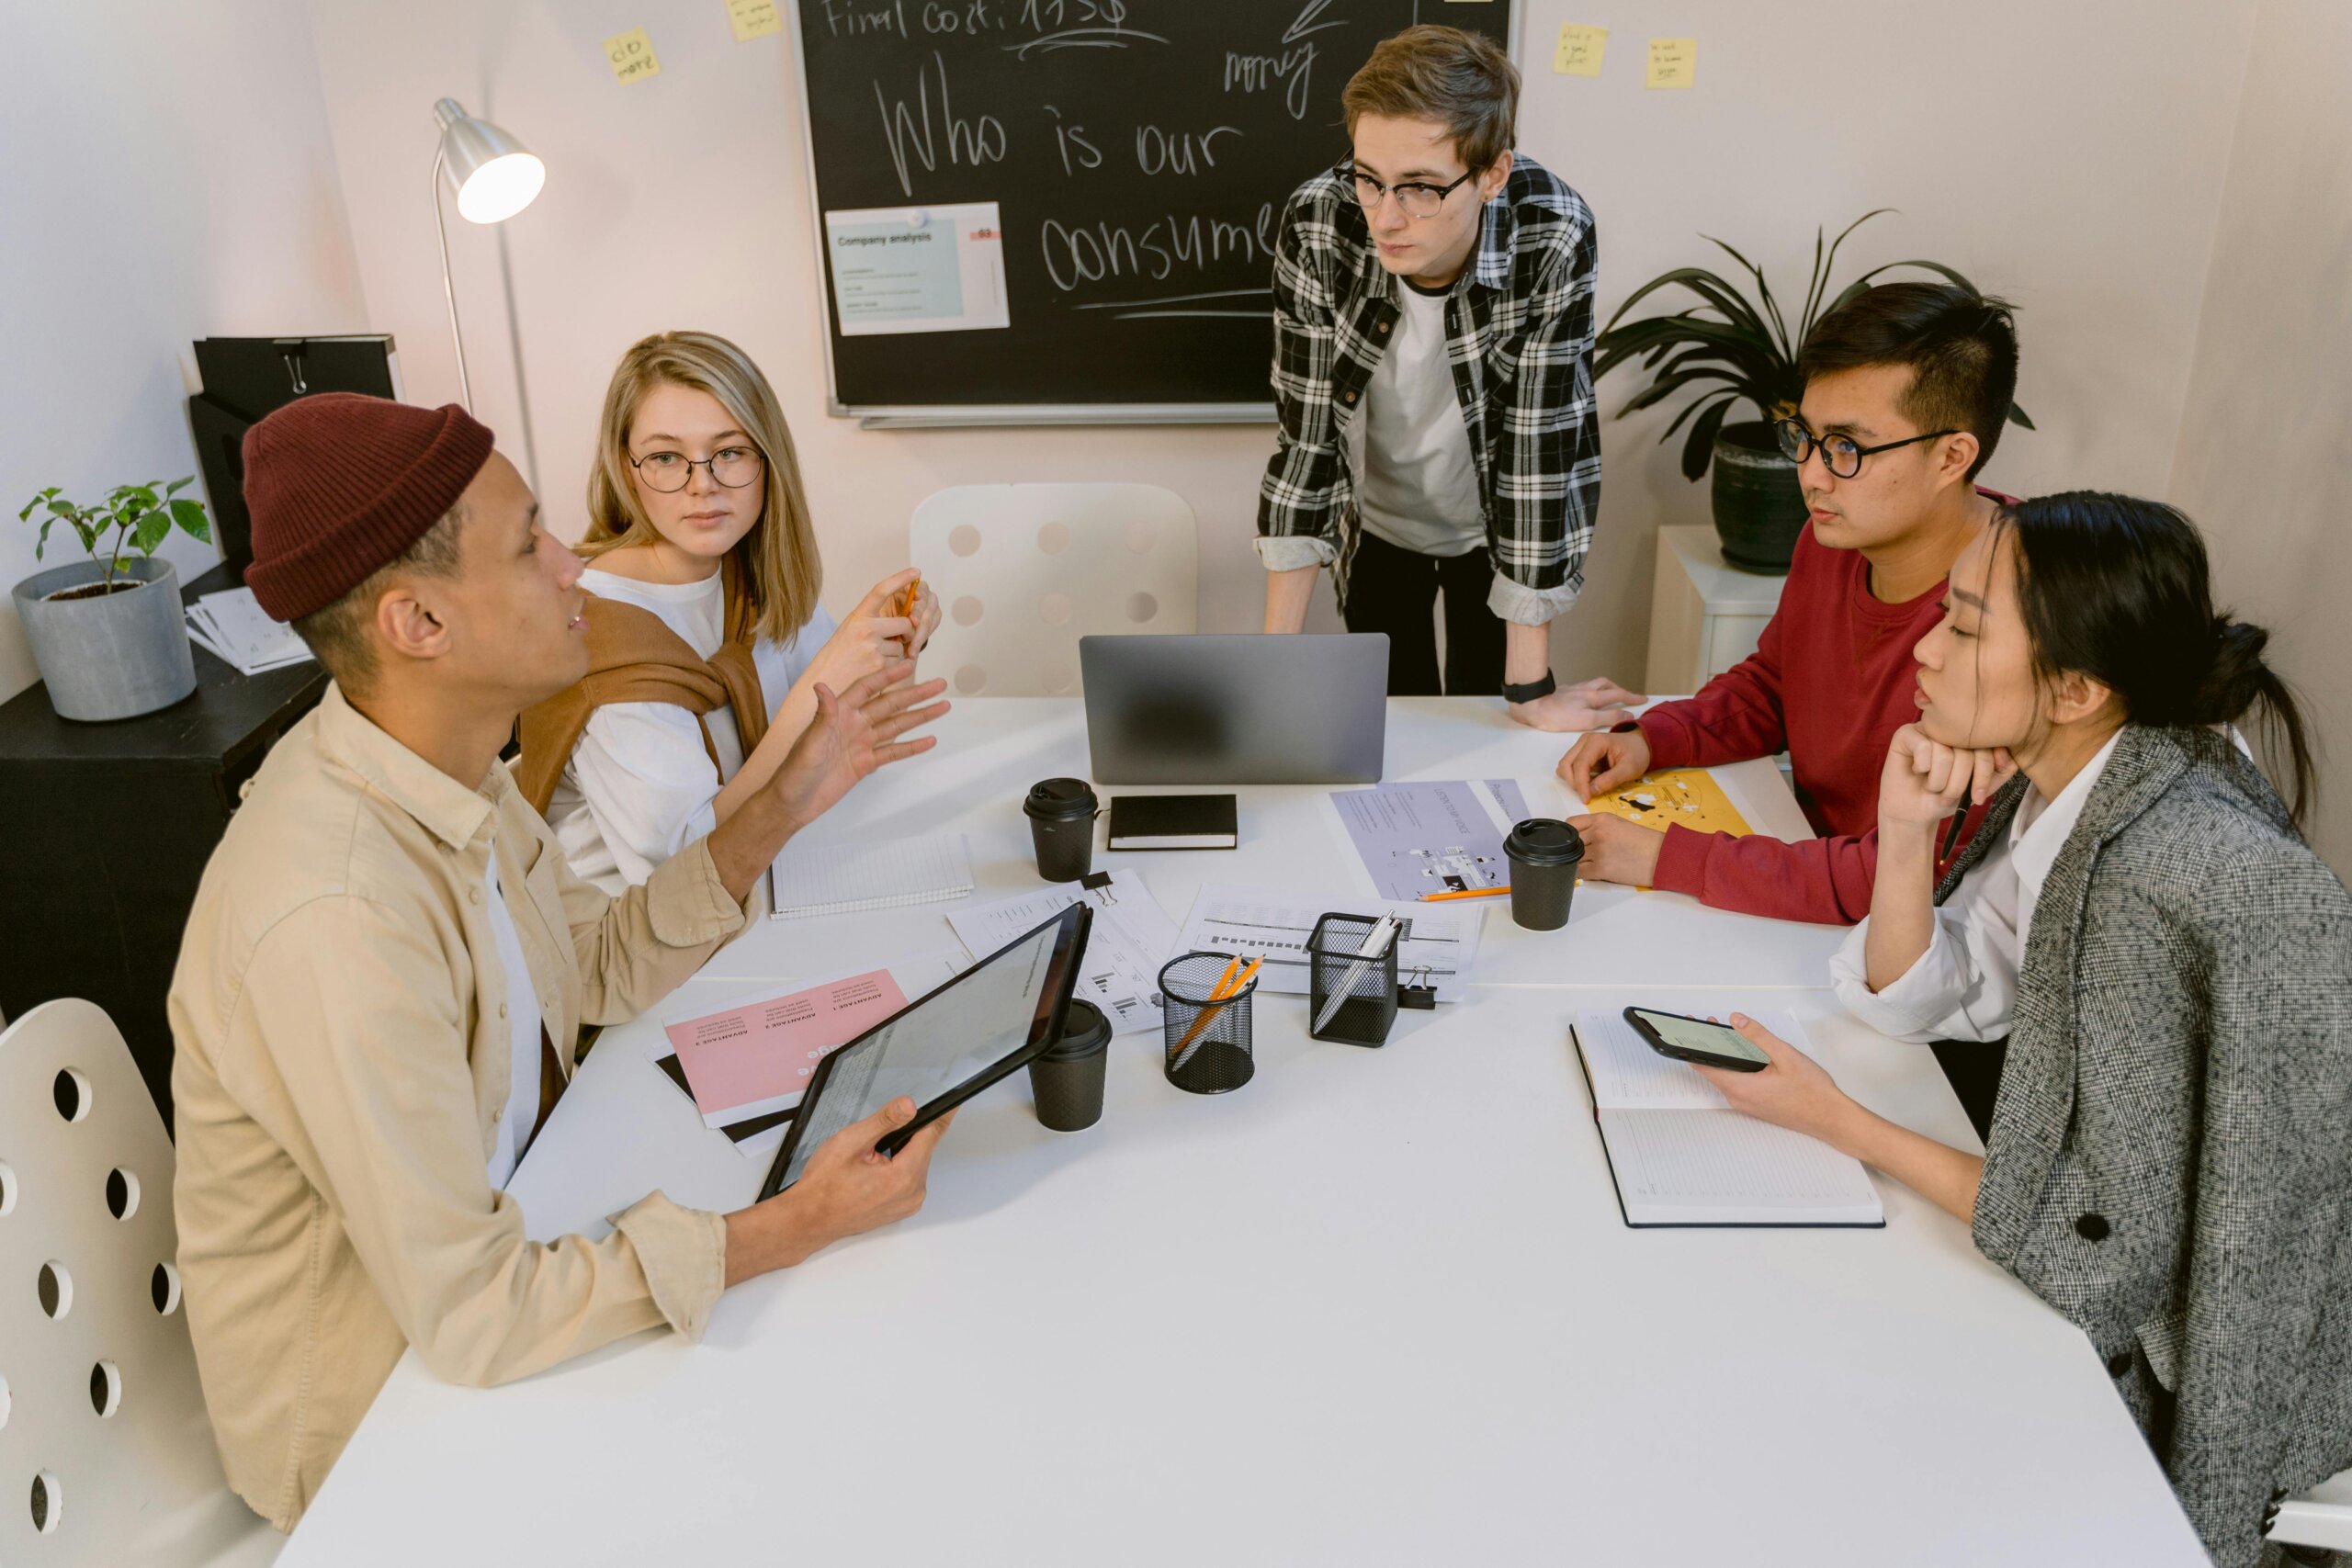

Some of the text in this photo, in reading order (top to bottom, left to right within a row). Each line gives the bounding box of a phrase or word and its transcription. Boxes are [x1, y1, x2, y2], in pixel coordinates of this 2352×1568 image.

[874, 50, 1243, 197] Who is our
[837, 231, 933, 248] Company analysis
[838, 993, 882, 1009] ADVANTAGE
[771, 1012, 816, 1028] ADVANTAGE
[702, 1029, 748, 1044] ADVANTAGE
